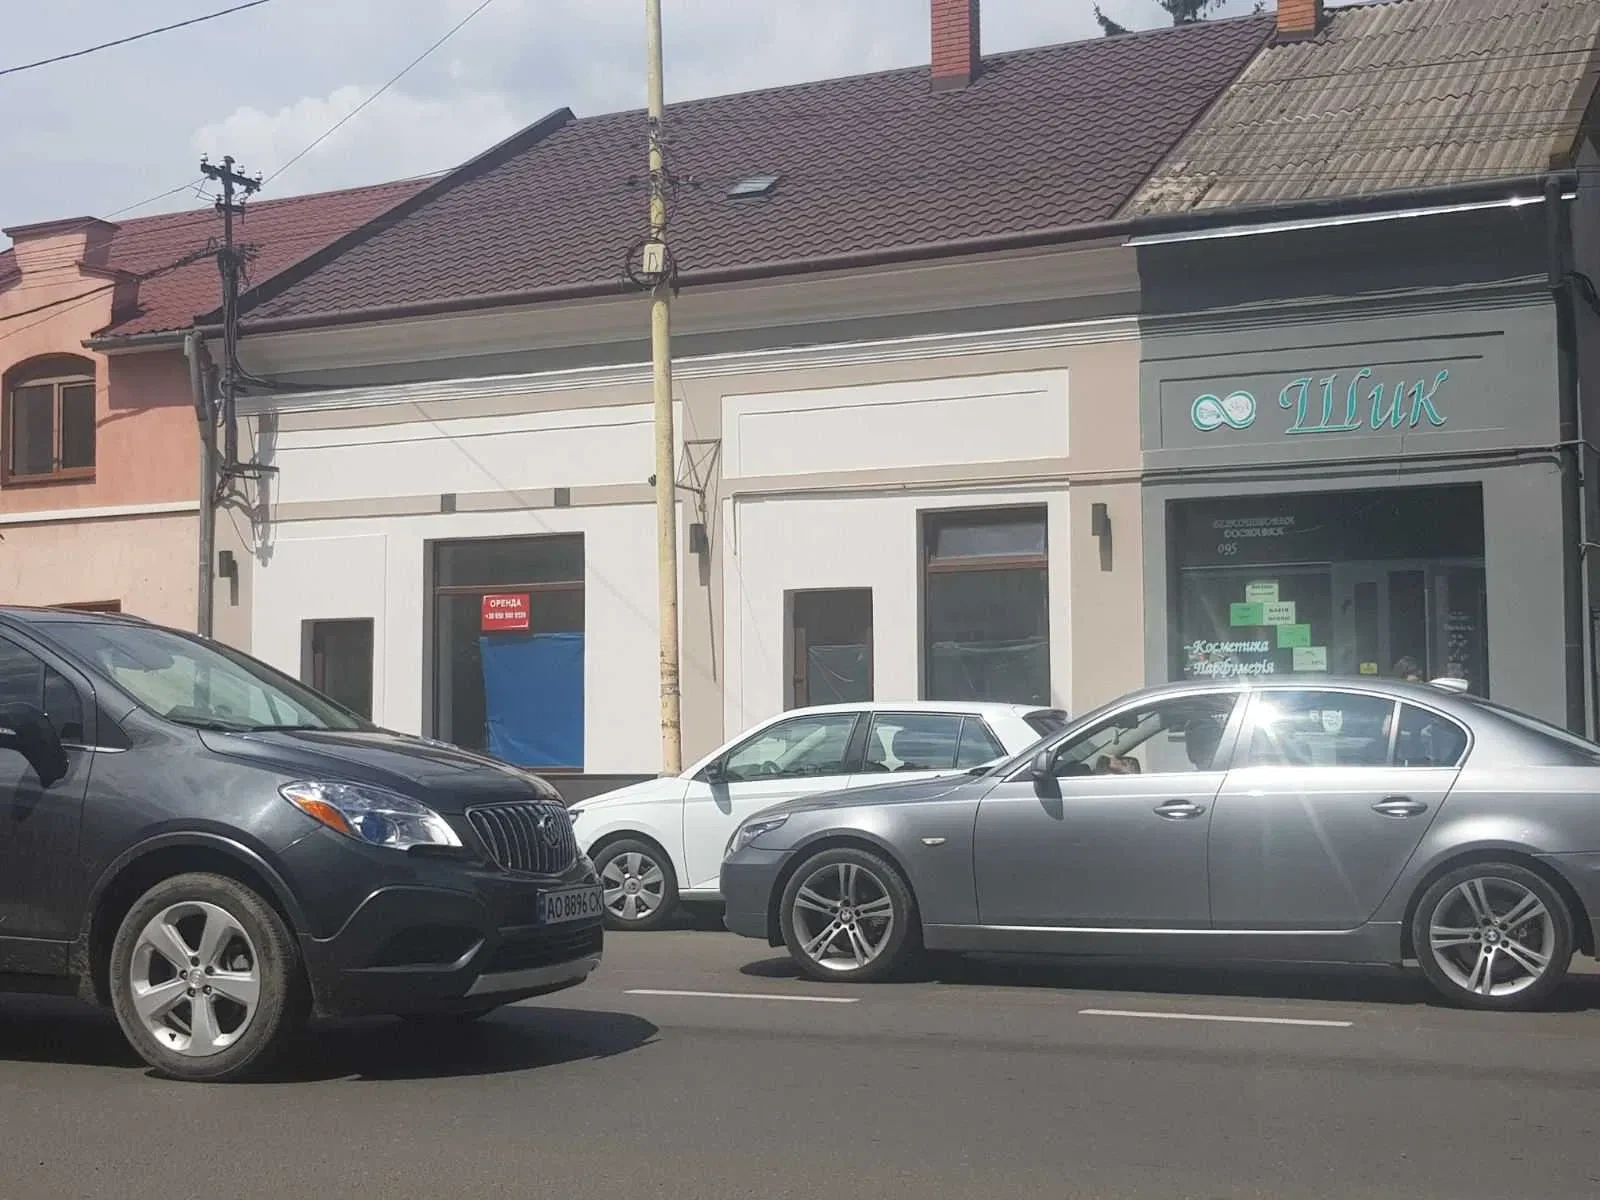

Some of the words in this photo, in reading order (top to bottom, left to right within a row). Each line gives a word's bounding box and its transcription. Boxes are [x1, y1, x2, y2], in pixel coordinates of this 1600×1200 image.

[1278, 367, 1449, 434] Шик
[490, 598, 521, 608] ОРЕНДА
[548, 897, 562, 918] AO
[564, 893, 587, 916] 8896
